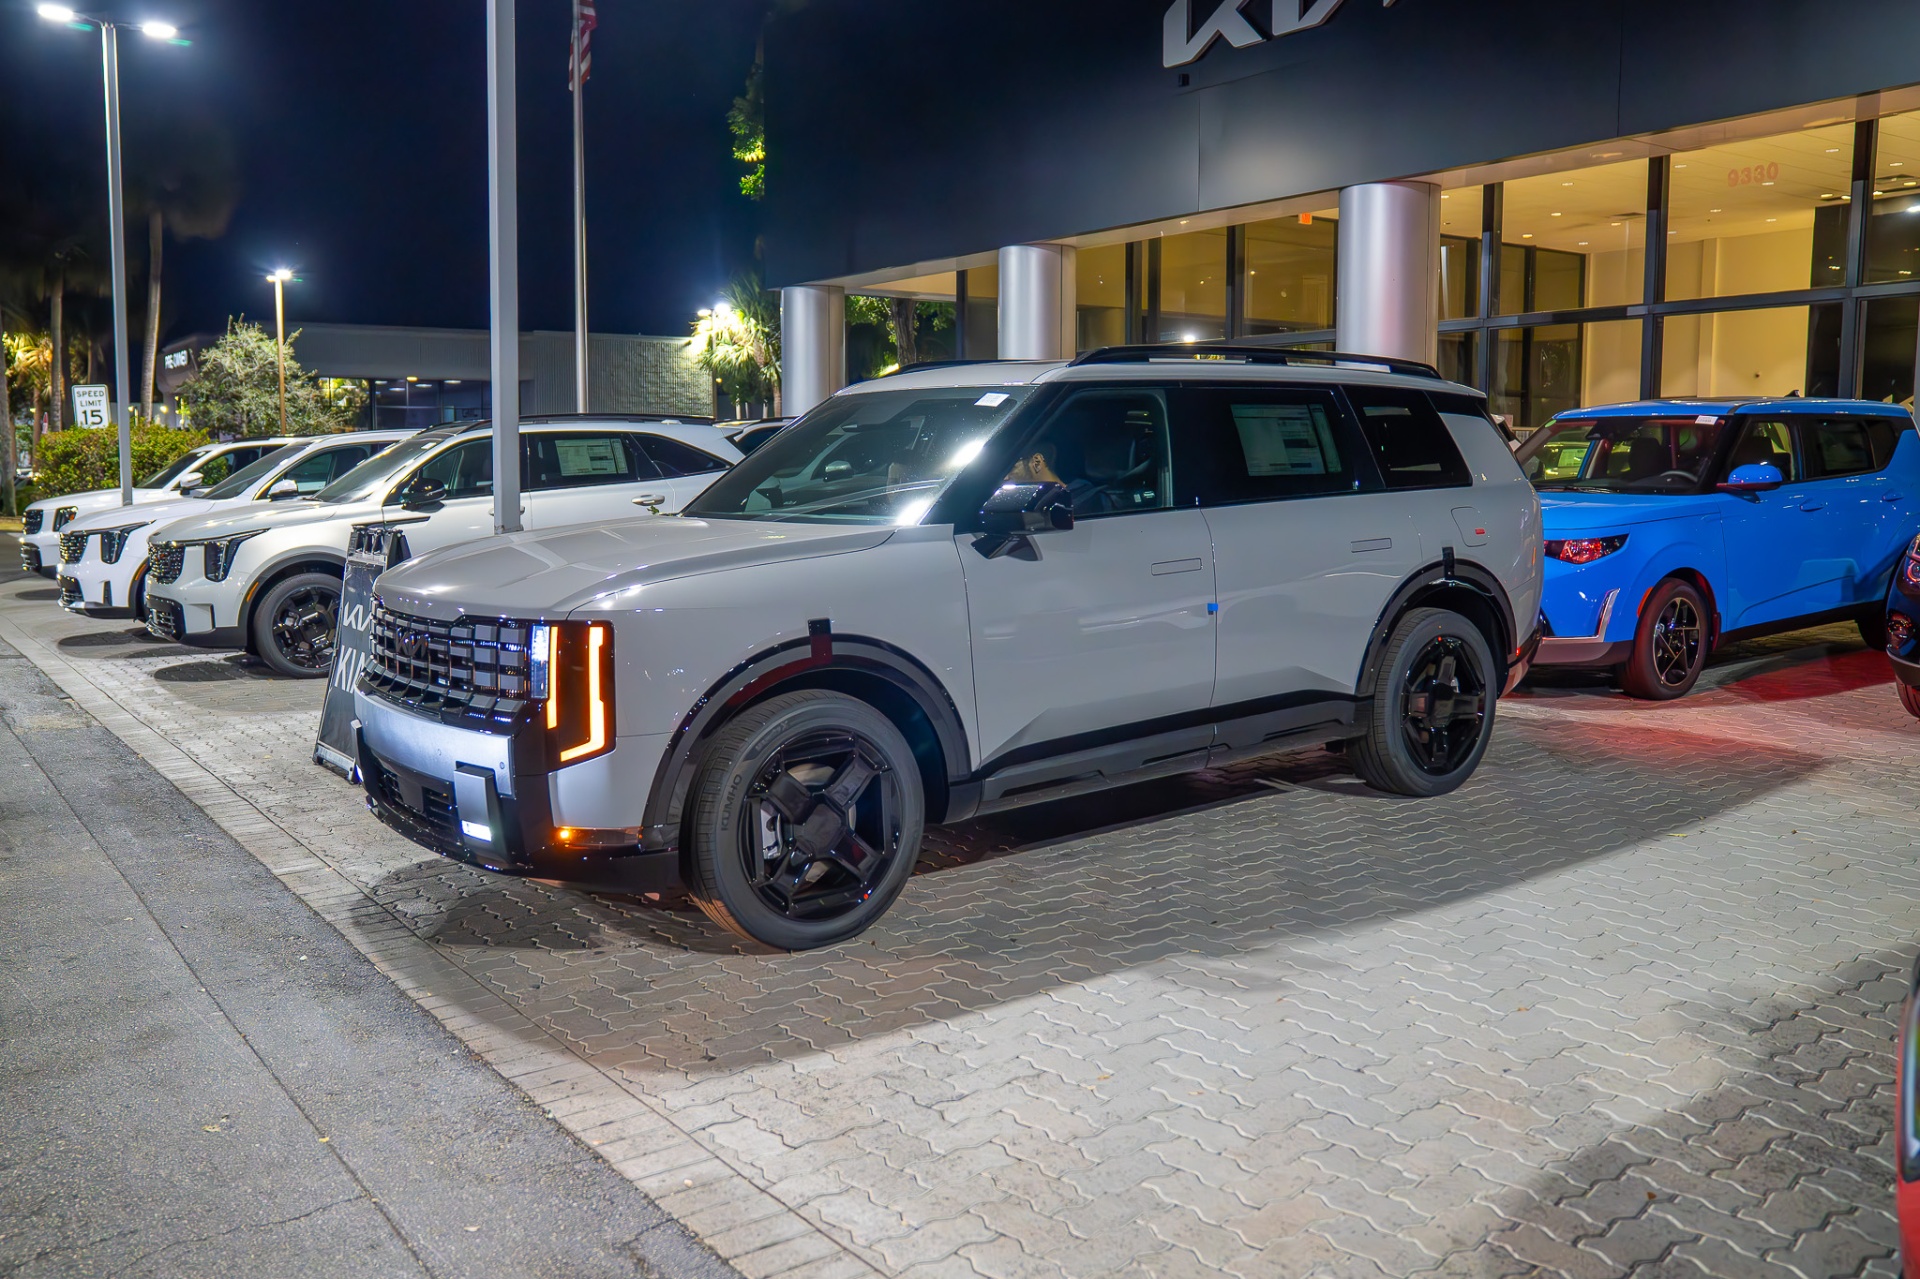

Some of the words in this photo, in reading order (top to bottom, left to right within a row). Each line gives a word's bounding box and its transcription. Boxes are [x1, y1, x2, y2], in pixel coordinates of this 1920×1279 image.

[1727, 162, 1778, 186] 9330
[76, 390, 105, 398] SPEED
[80, 399, 102, 408] LIMIT
[81, 409, 103, 425] 15
[721, 774, 743, 832] KUMHO
